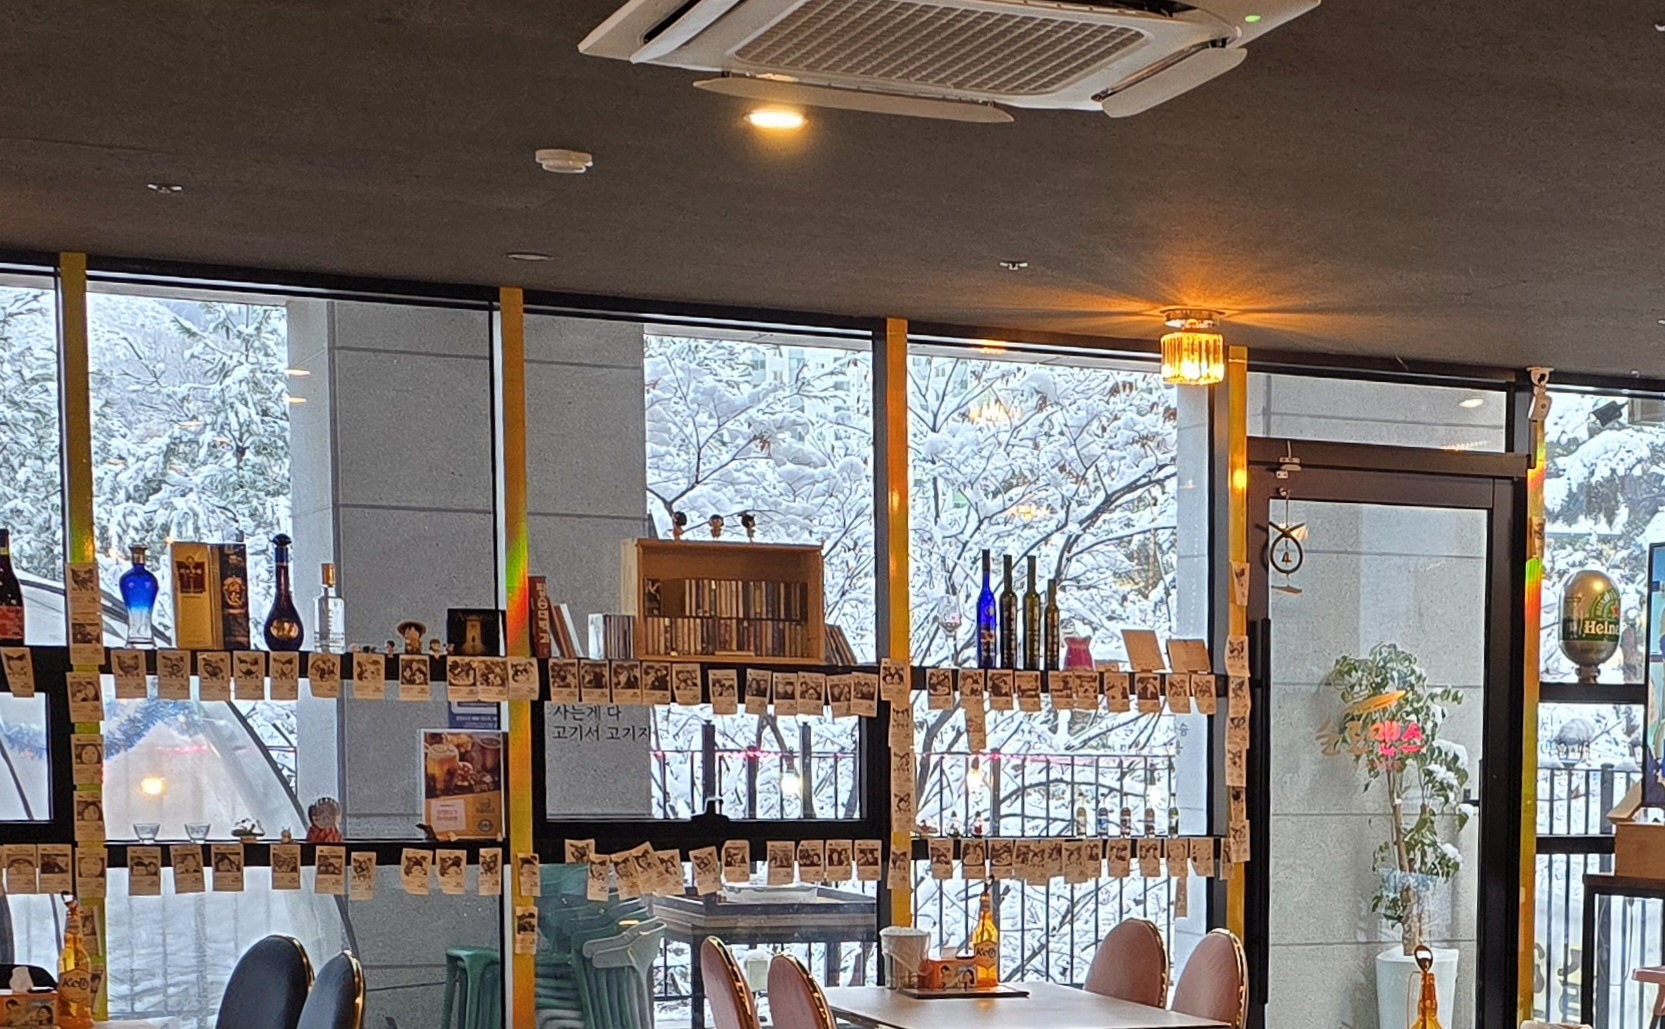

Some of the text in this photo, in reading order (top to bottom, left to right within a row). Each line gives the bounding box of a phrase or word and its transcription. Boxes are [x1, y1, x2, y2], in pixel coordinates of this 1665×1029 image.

[553, 705, 622, 722] 사는게 다
[552, 725, 601, 742] 고기서
